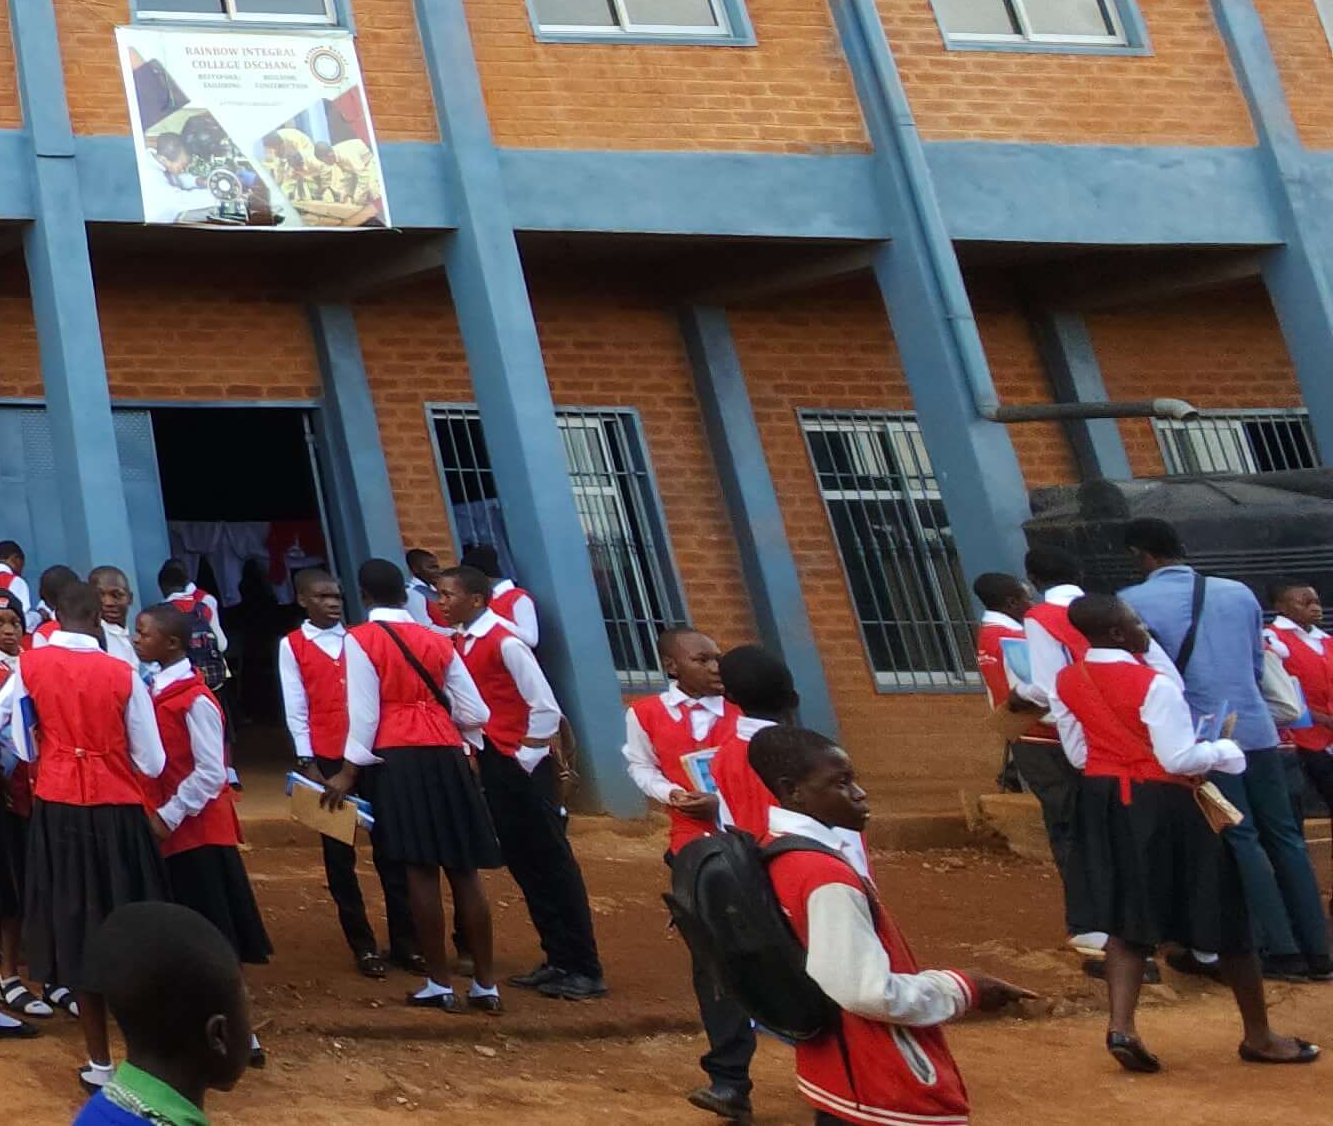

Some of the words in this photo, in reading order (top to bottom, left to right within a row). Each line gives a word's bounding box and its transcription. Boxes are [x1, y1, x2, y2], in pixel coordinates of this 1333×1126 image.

[184, 45, 239, 56] RAINBOW
[241, 46, 297, 57] INTEGRAL
[191, 59, 241, 70] COLLEGE
[243, 60, 297, 70] DSCHANG
